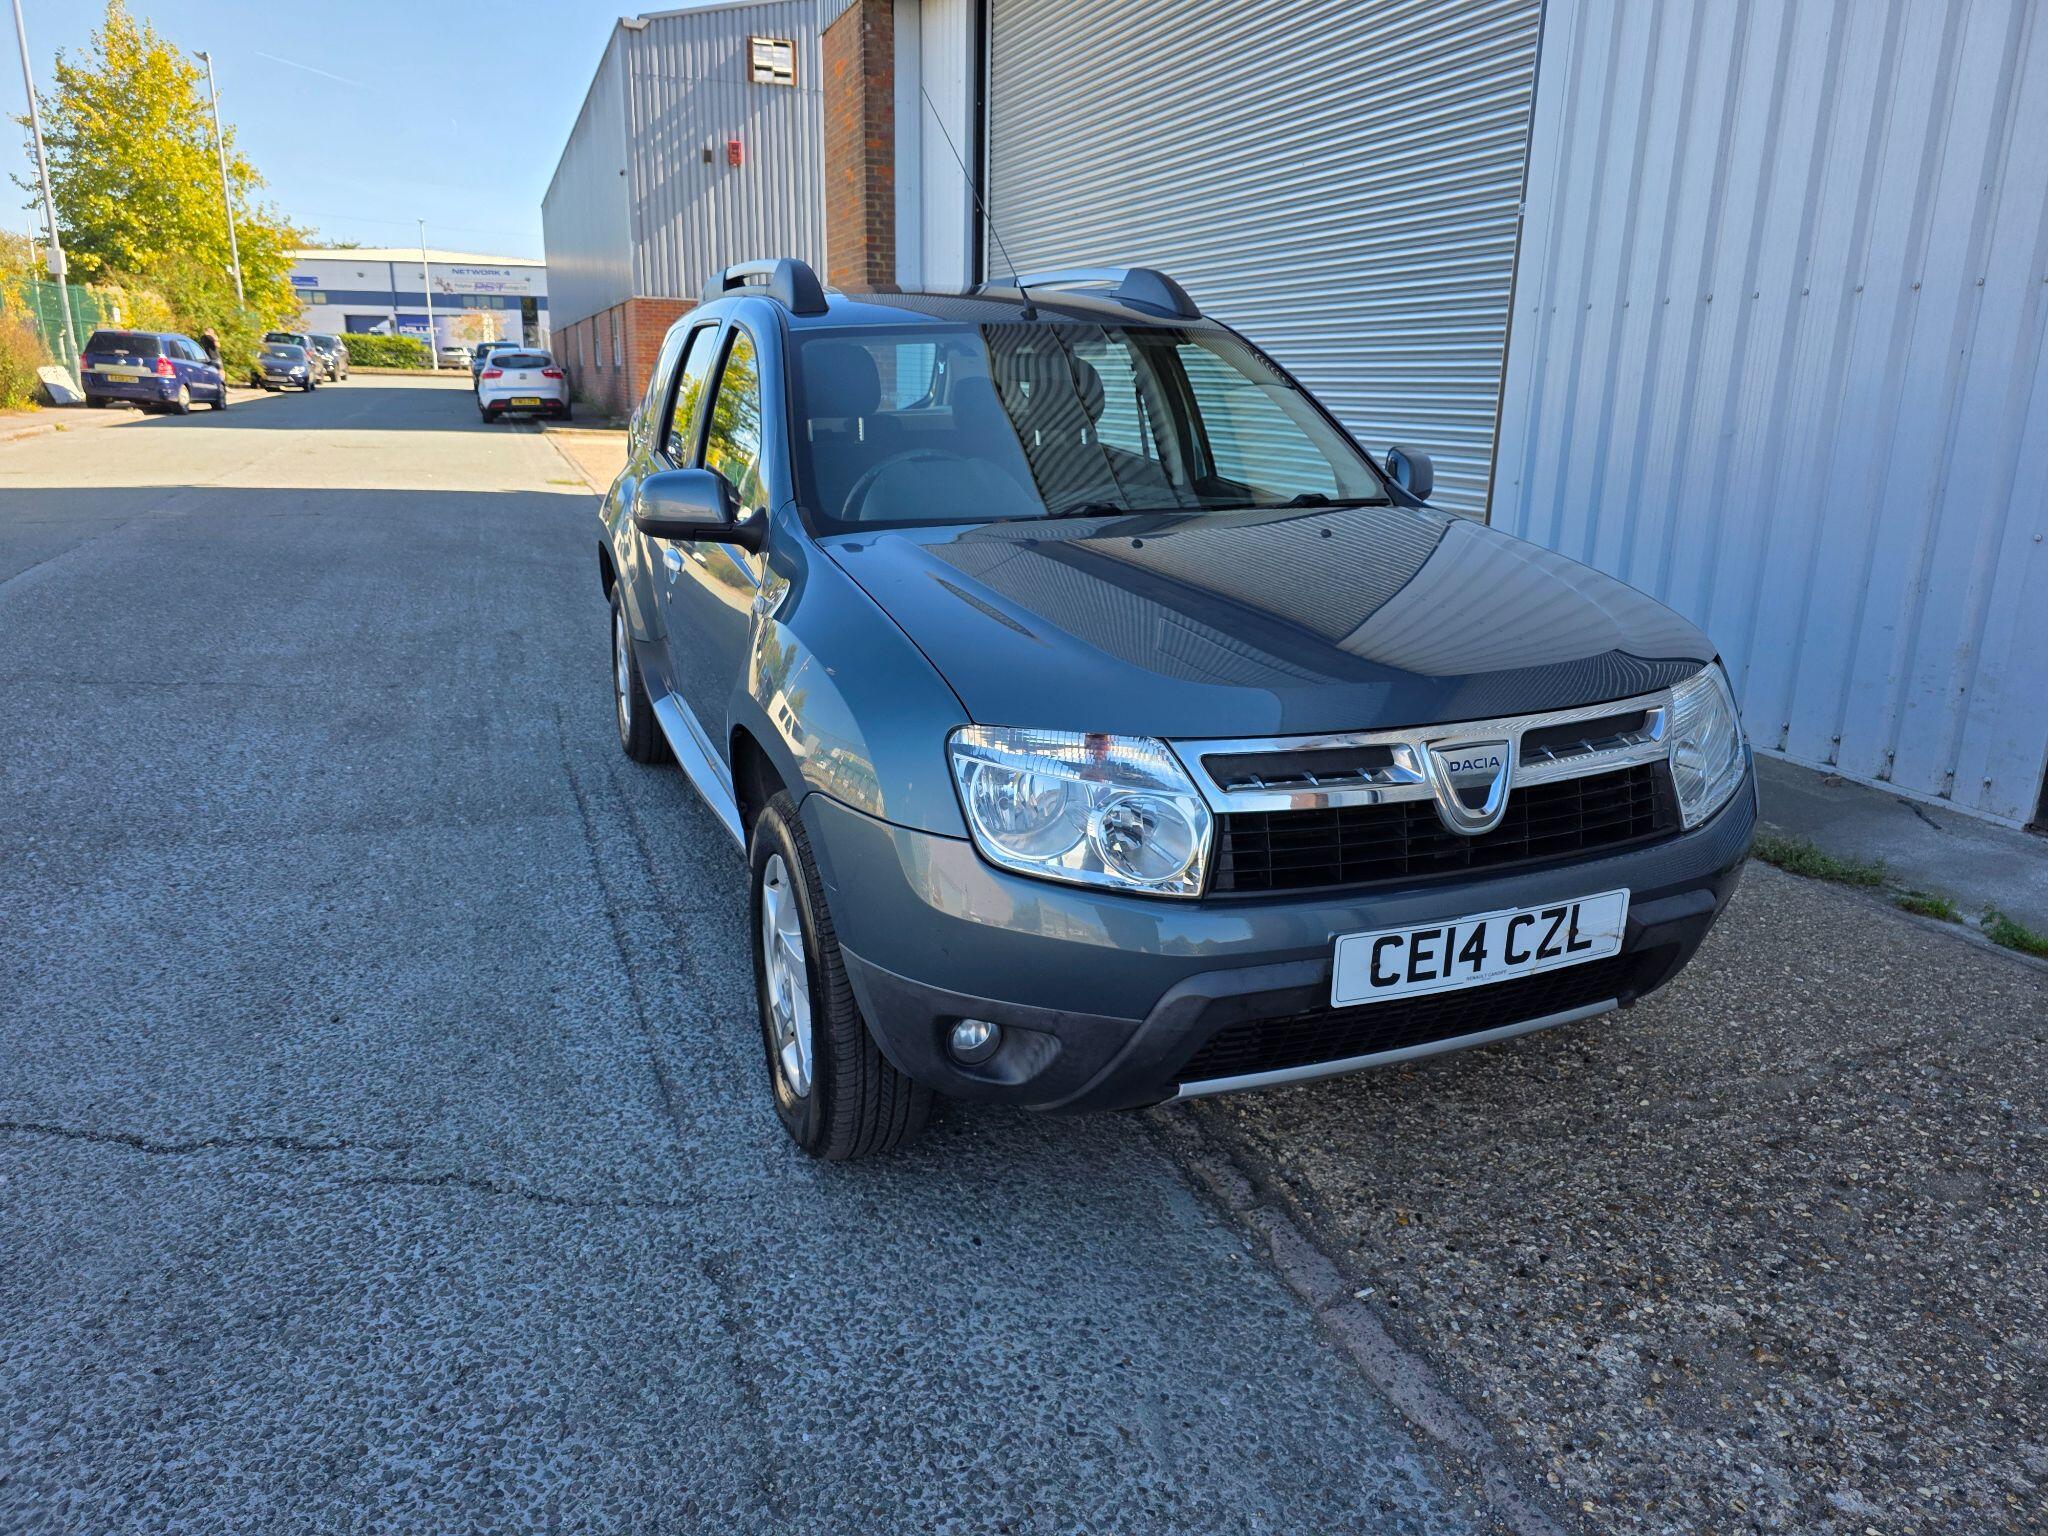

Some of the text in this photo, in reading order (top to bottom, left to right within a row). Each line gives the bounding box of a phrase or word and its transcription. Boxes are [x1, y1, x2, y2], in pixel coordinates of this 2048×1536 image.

[452, 268, 500, 276] NETWORK
[1450, 756, 1500, 772] DACIA
[1370, 903, 1593, 988] CE14 CZL
